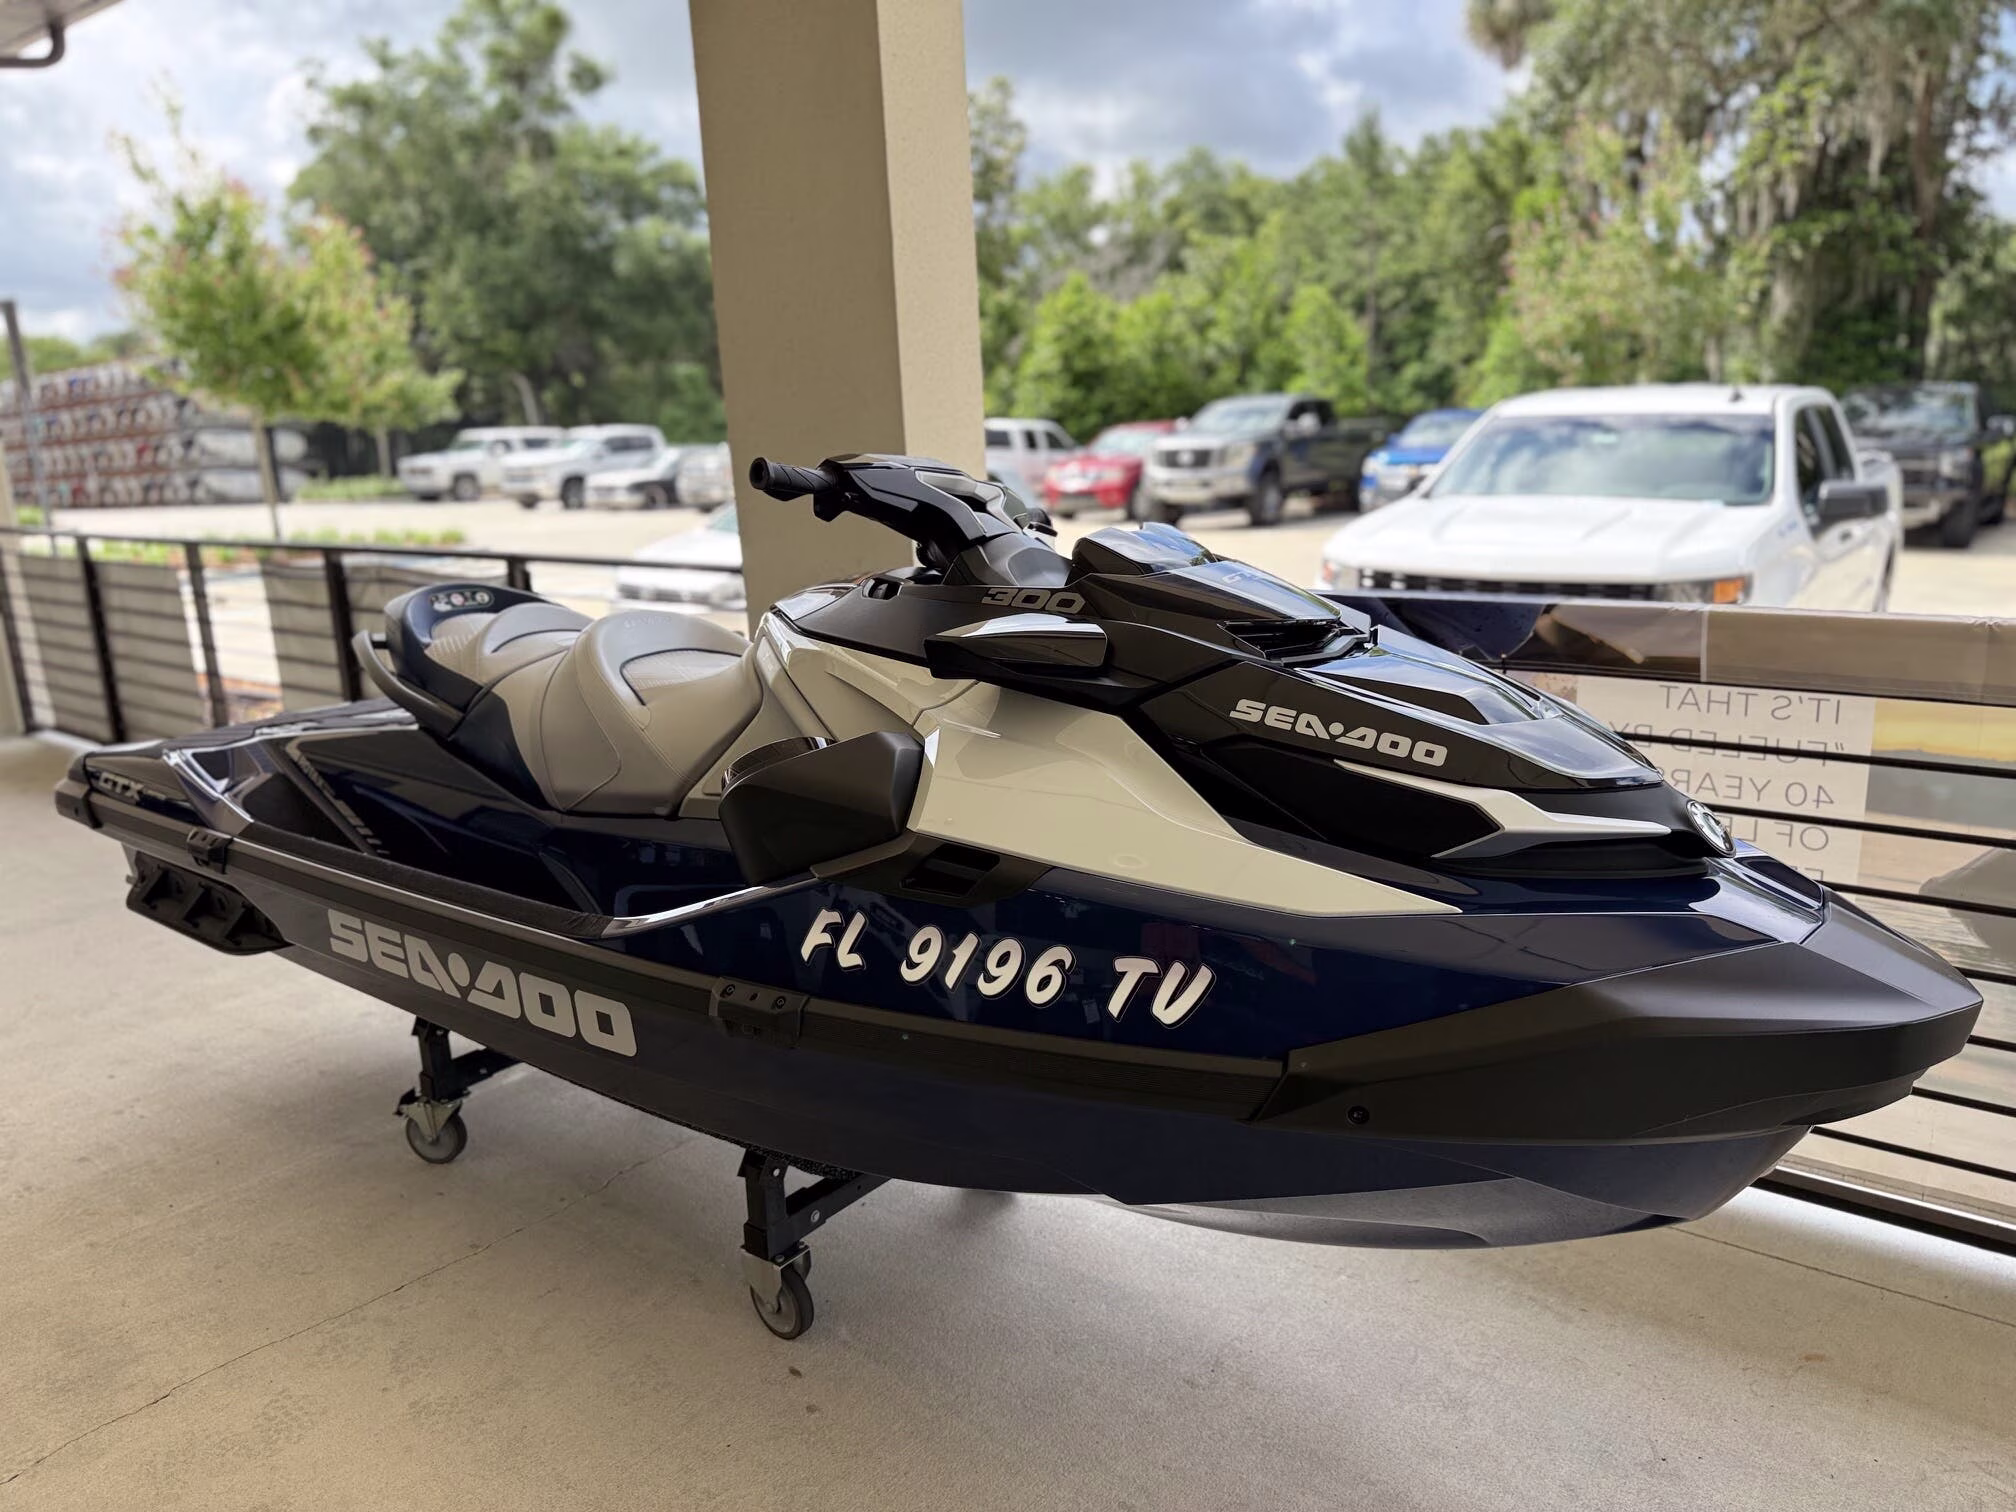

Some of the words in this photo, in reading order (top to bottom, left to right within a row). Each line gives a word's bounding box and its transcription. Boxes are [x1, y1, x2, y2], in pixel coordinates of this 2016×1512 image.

[981, 587, 1086, 615] 300
[99, 771, 146, 801] GTX
[800, 908, 867, 972] FL
[900, 925, 1077, 1008] 9196
[1105, 955, 1217, 1029] TV
